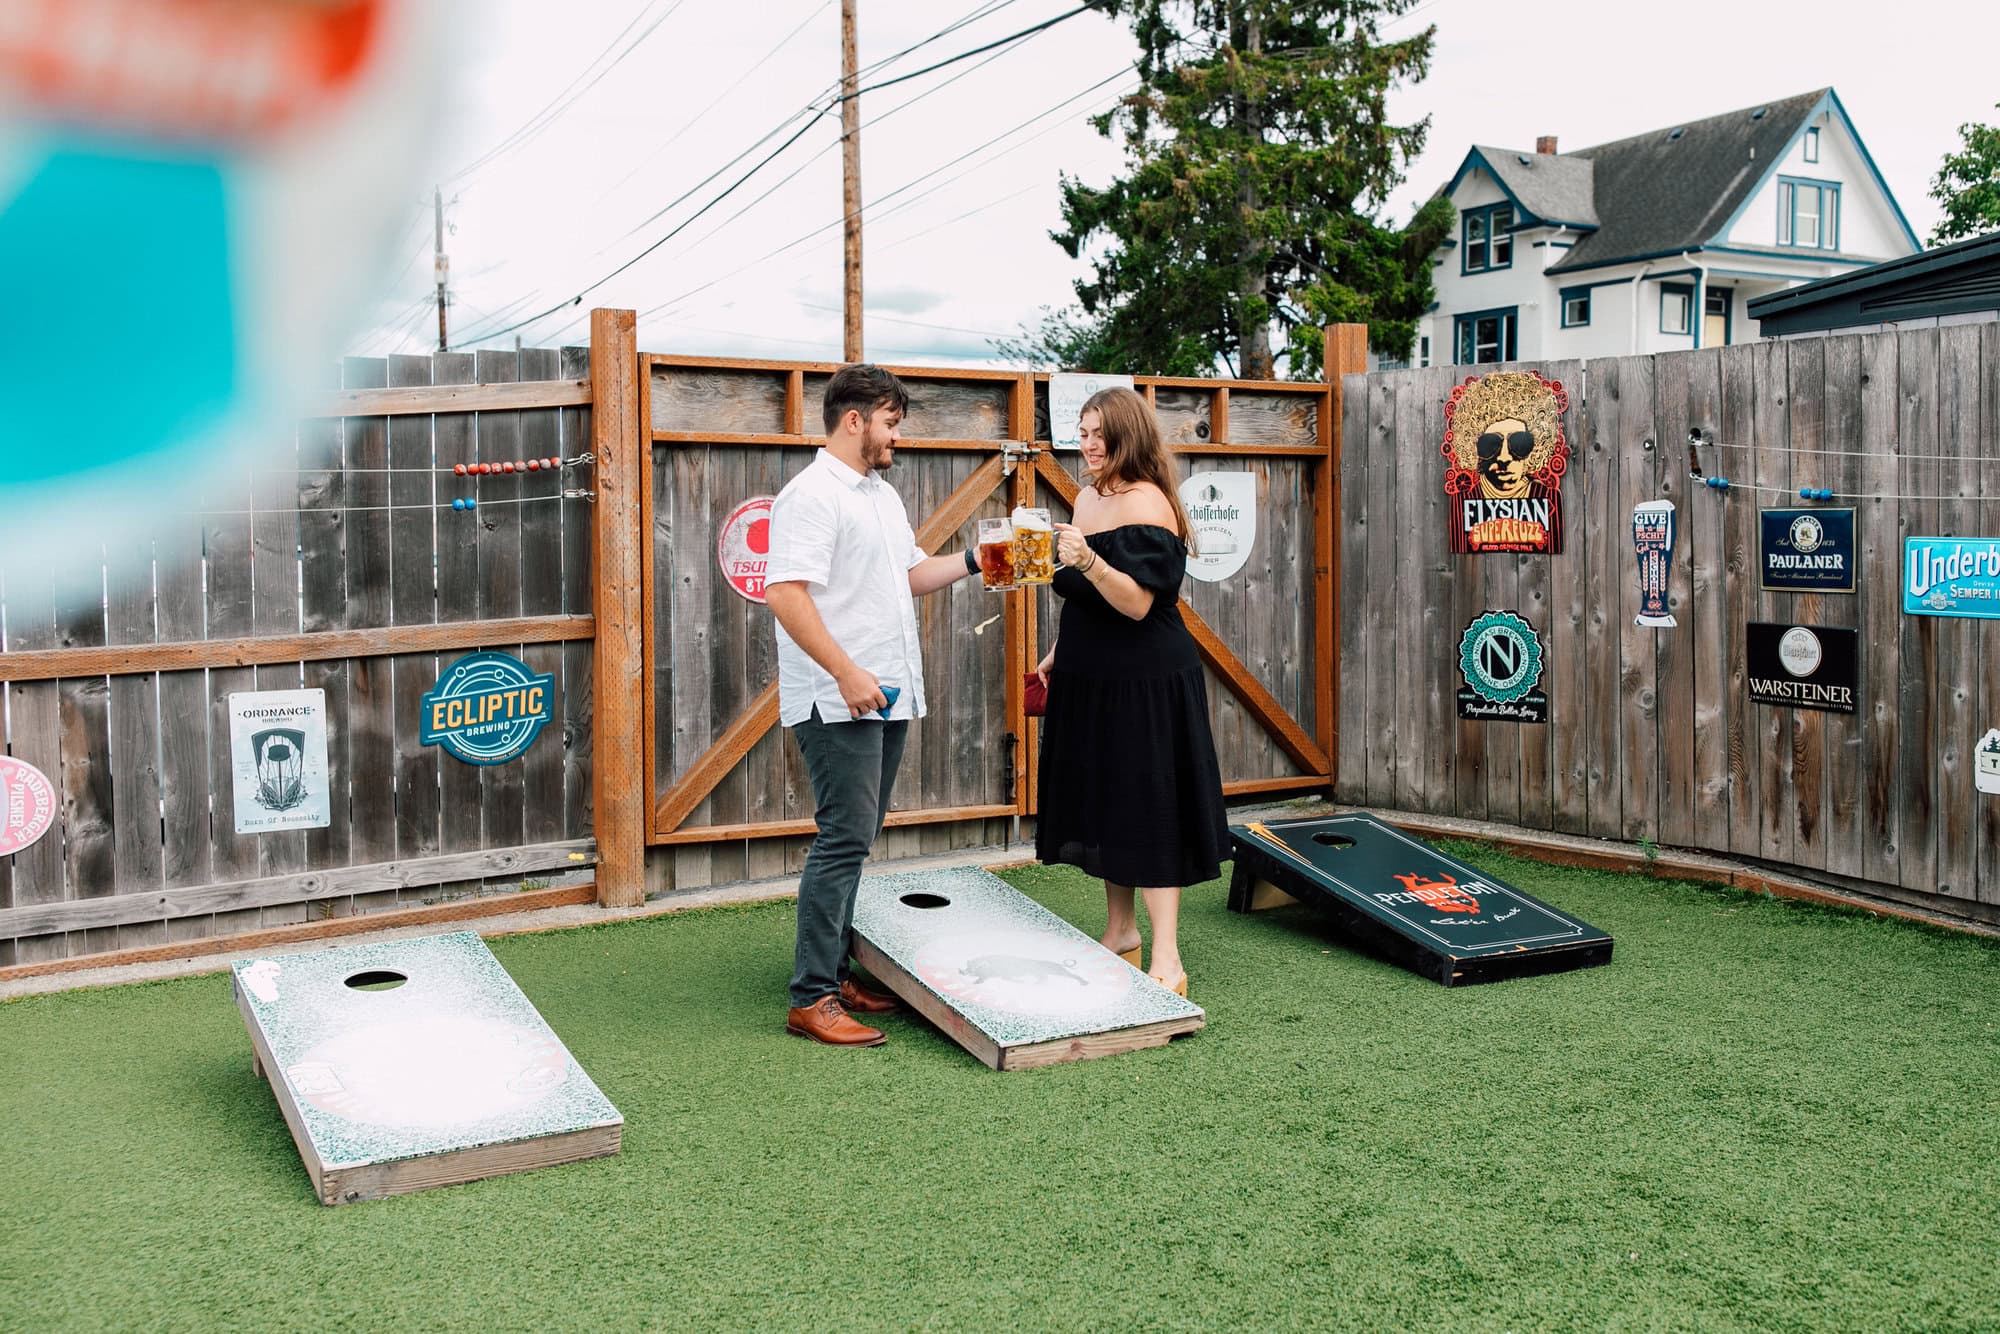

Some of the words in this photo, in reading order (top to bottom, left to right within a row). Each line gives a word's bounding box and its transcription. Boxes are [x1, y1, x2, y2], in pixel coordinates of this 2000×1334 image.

[1189, 504, 1239, 522] chöfferhofer
[1464, 499, 1549, 532] ELYSIAN
[1634, 513, 1667, 525] GIVE
[1473, 520, 1543, 543] SUPERFUZZ
[1768, 553, 1844, 569] PAULANER
[1909, 544, 2000, 596] Underb
[745, 578, 764, 593] ST
[1950, 584, 1991, 599] SEMPER
[1486, 635, 1513, 680] N
[1749, 678, 1852, 704] WARSTEINER
[243, 706, 310, 718] ORDNANCE
[432, 687, 543, 730] ECLIPTIC
[466, 721, 510, 737] BREWING
[10, 783, 24, 828] PILSNER
[16, 767, 49, 841] RADEBERGER
[1372, 881, 1499, 906] PENDLETON
